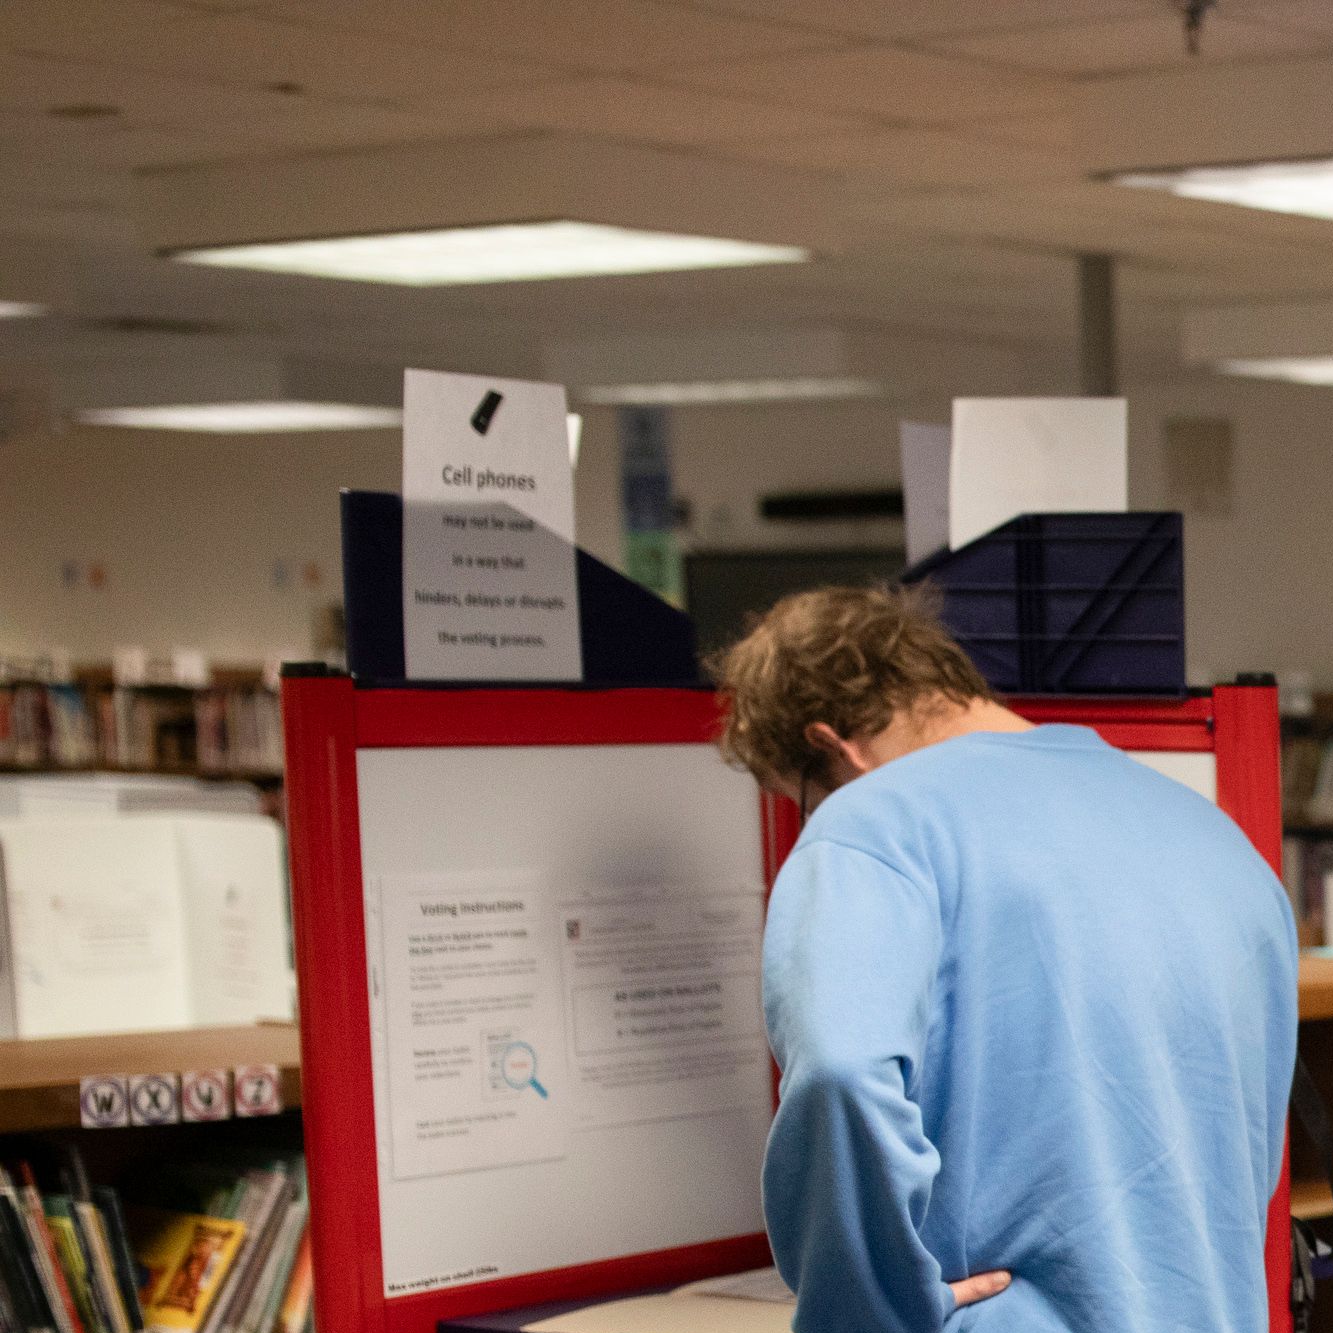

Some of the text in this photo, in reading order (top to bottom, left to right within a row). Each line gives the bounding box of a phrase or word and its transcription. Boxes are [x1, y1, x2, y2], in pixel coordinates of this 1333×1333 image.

[442, 465, 536, 491] Cell phones
[420, 902, 458, 918] Voting
